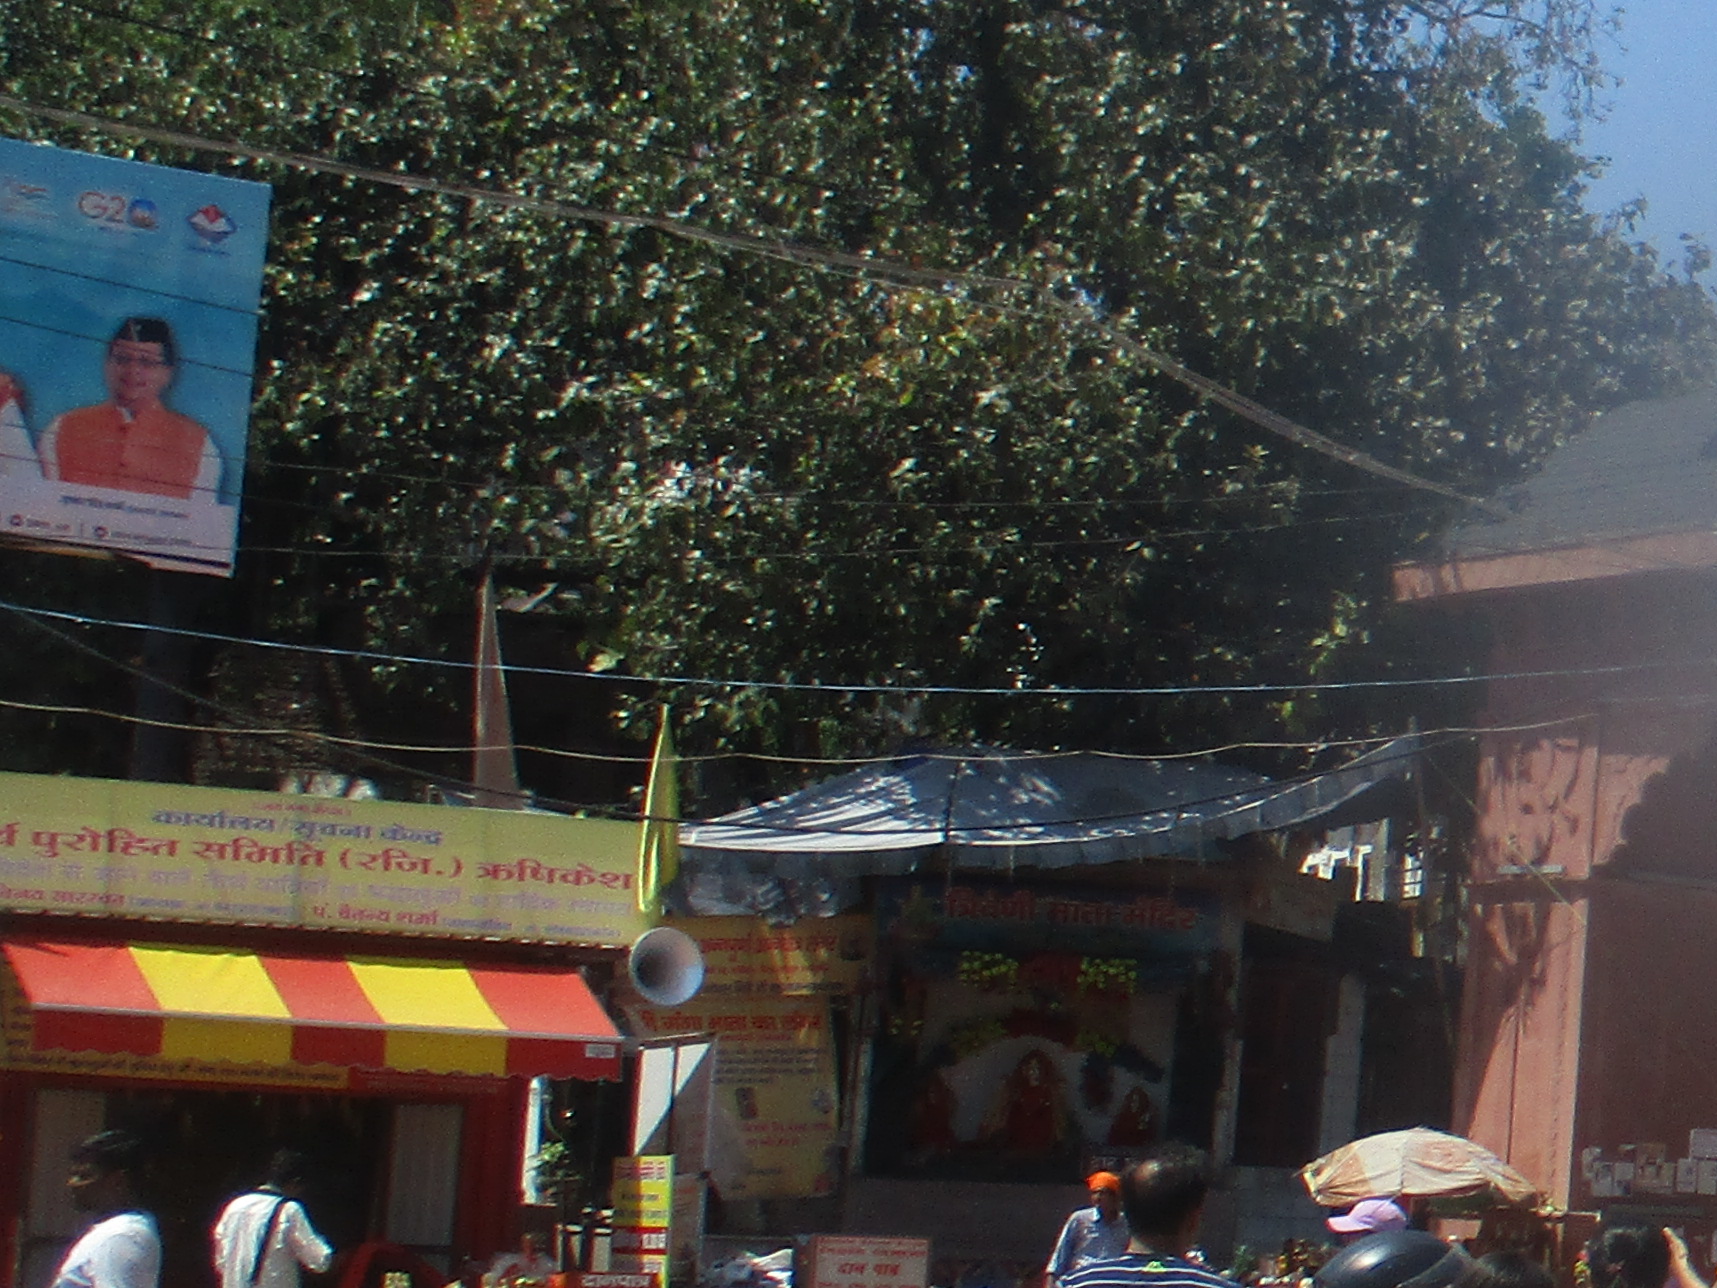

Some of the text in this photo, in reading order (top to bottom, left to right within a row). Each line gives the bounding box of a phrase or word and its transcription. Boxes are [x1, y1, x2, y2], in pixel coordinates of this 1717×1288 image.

[30, 826, 181, 858] पुरोहित
[192, 836, 326, 867] समिति
[339, 848, 463, 878] (रजि.)
[477, 859, 635, 890] ऋषिकेश
